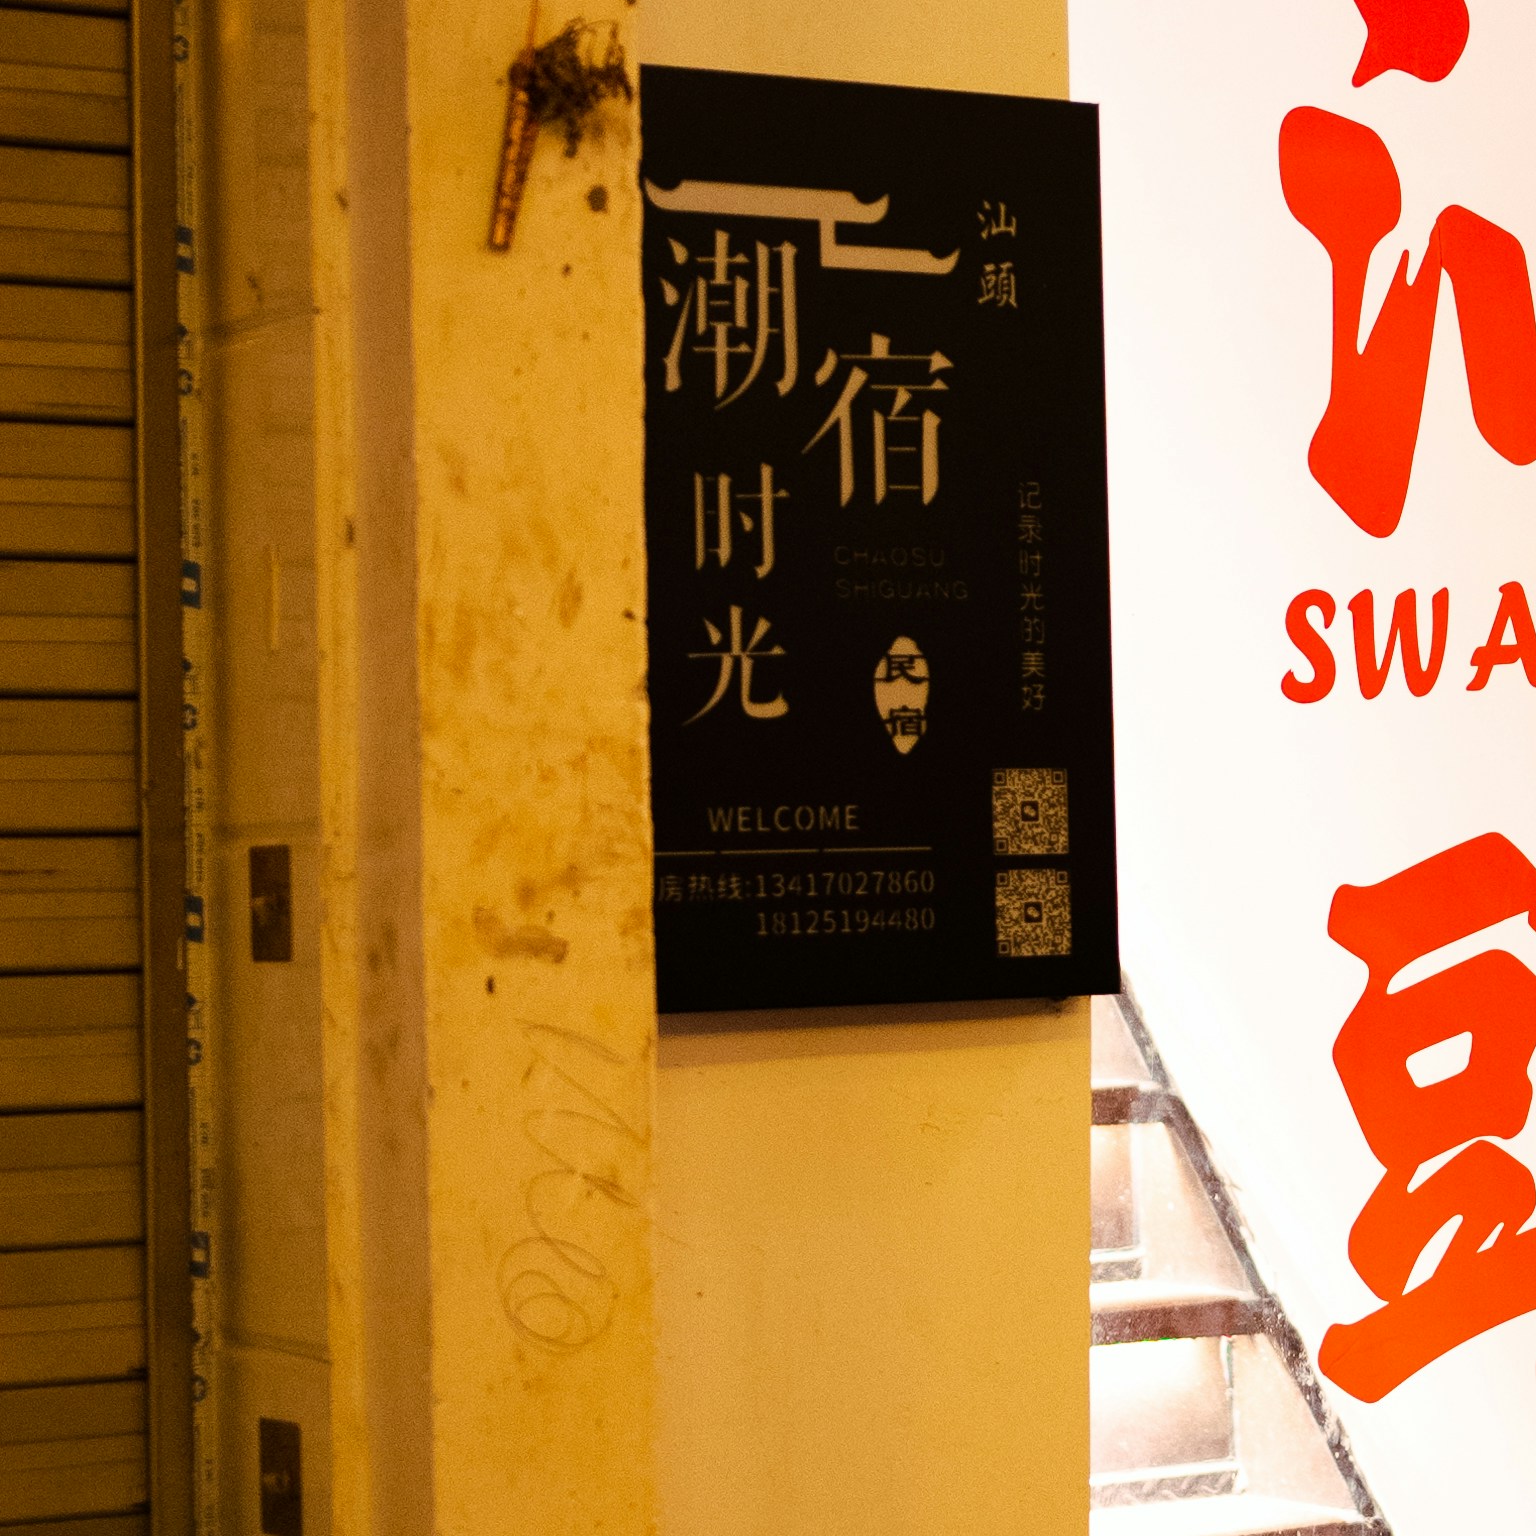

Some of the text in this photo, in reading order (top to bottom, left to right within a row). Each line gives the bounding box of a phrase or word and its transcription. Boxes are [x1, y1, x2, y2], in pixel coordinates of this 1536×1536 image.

[976, 199, 1018, 309] 汕頭
[834, 545, 945, 568] CHAOSU
[682, 462, 791, 726] 时光
[834, 578, 970, 601] SHIGUANG
[1017, 480, 1047, 712] 记录时光的美好
[707, 804, 860, 833] WELCOME
[756, 907, 937, 937] 18125194480
